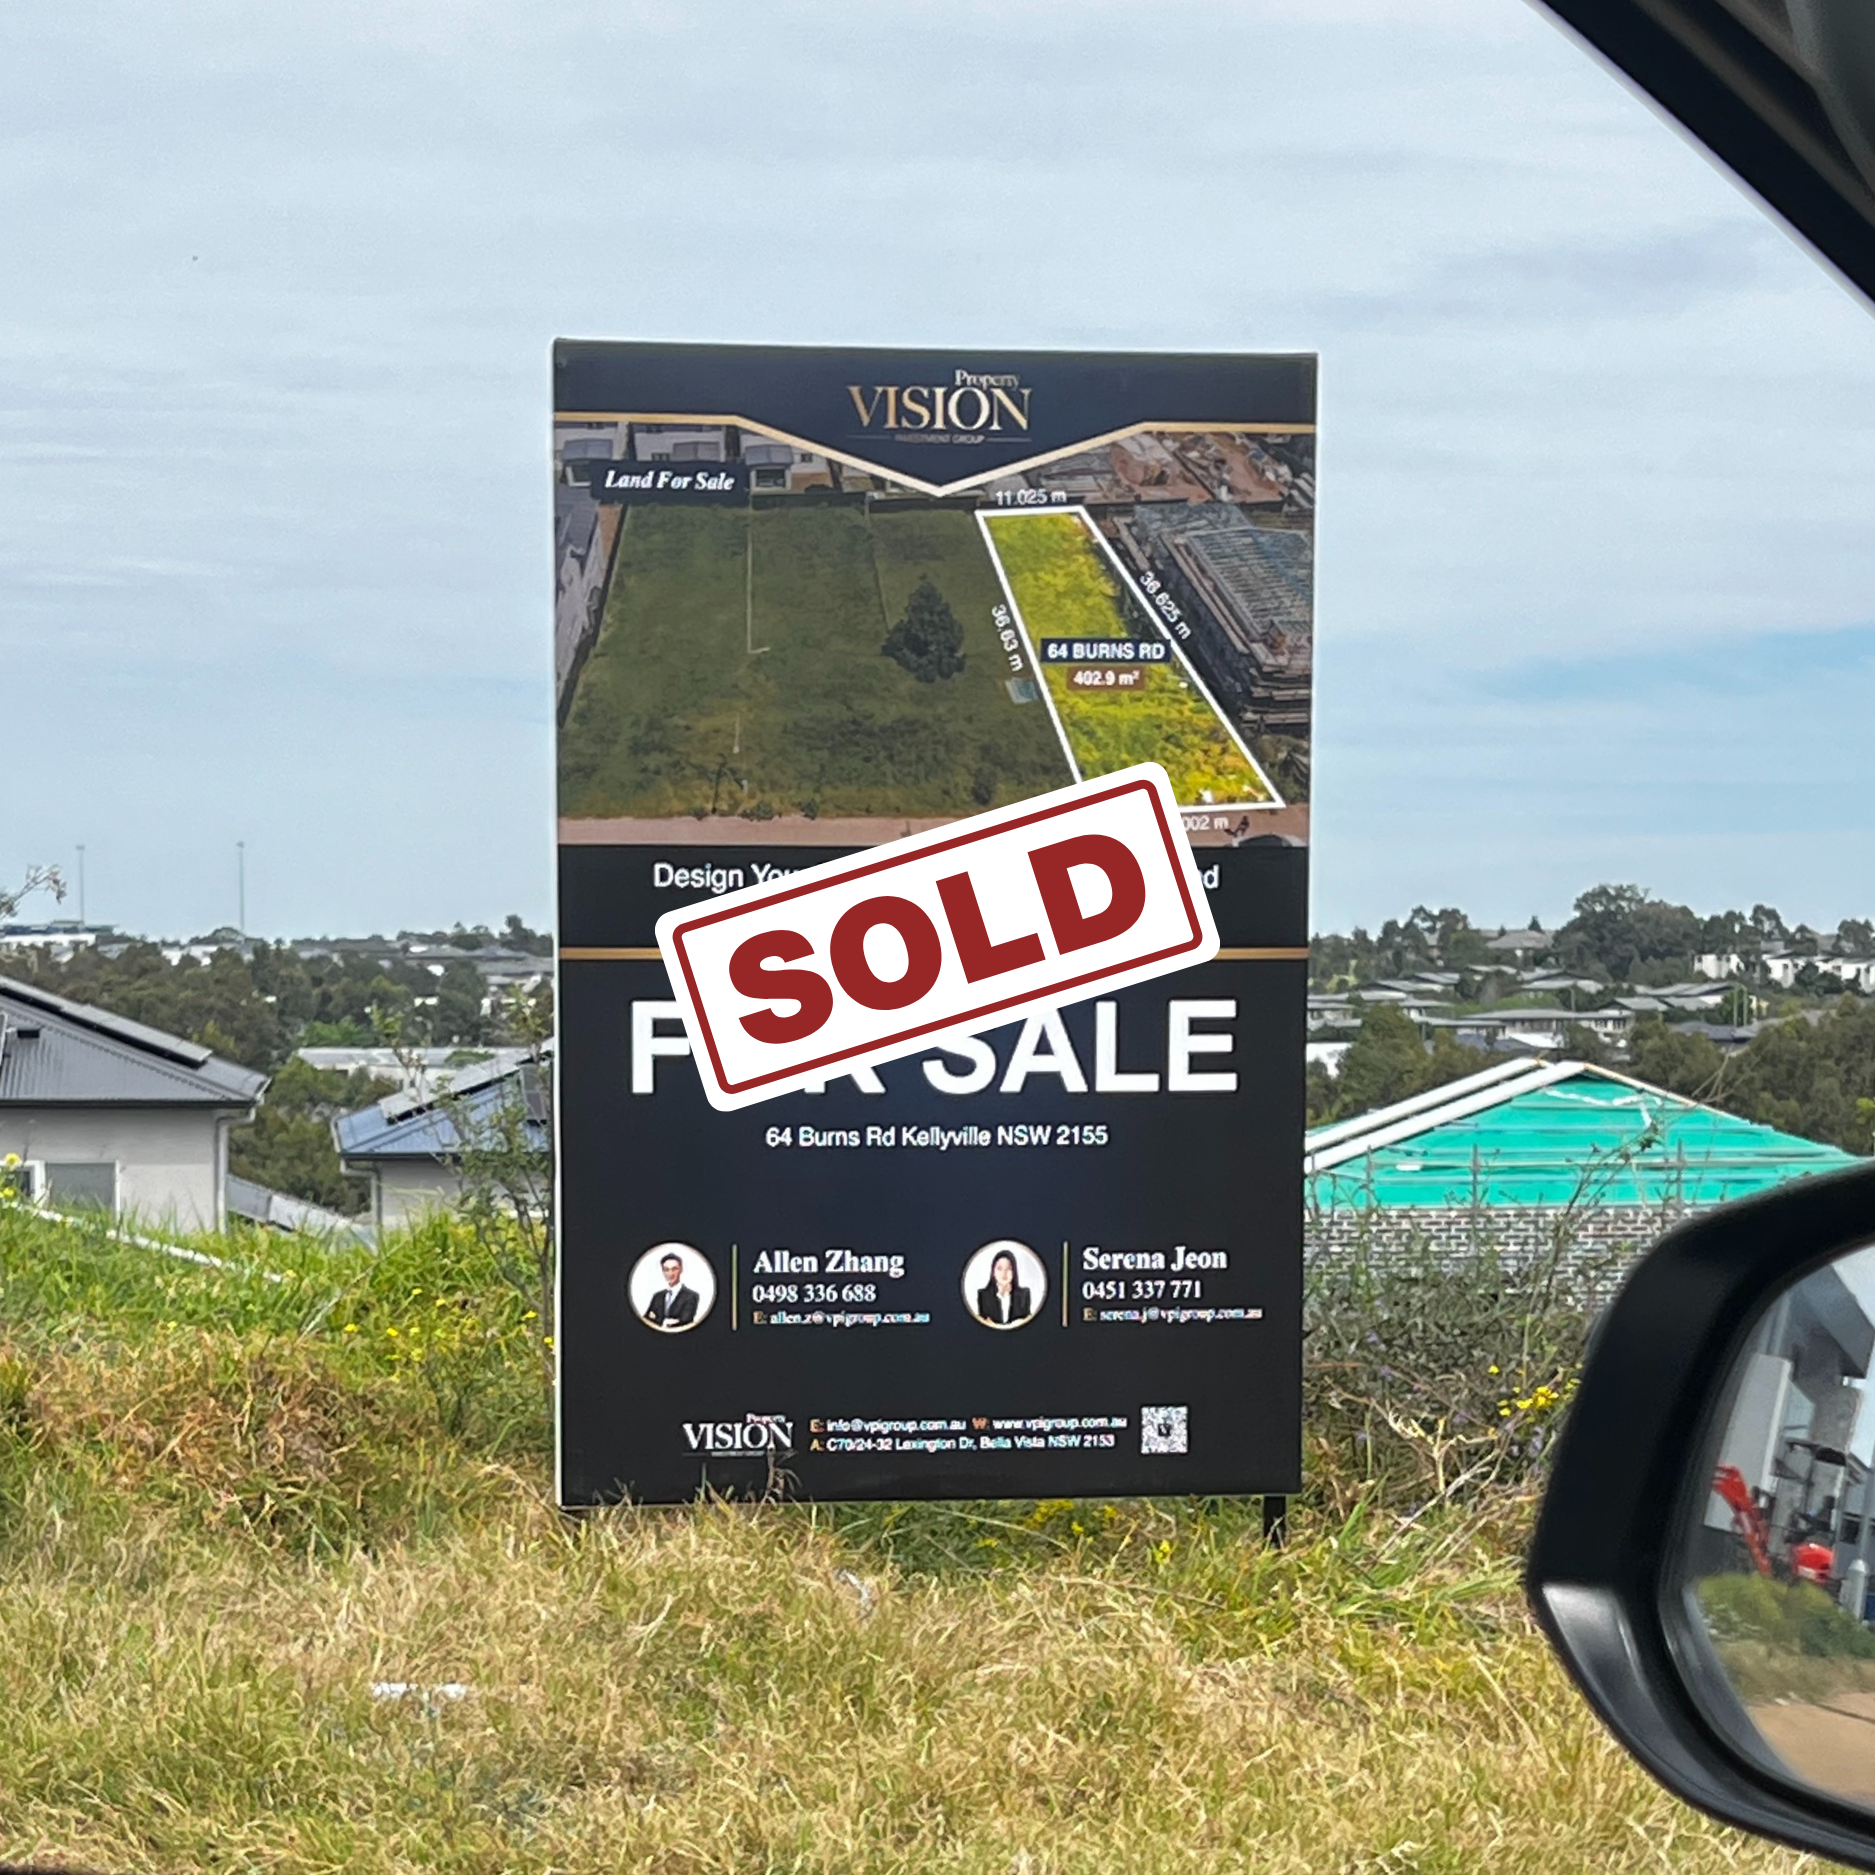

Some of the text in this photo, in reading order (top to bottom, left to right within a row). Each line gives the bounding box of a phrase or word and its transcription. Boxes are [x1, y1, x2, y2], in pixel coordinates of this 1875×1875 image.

[846, 385, 1032, 431] VISION
[604, 469, 735, 491] Land For Sale
[995, 488, 1068, 506] 11.025 m
[1174, 619, 1192, 640] m
[1047, 641, 1166, 660] 64 BURNS RD
[1008, 653, 1024, 672] m
[1073, 669, 1116, 686] 402.9
[1213, 816, 1229, 830] m
[653, 862, 744, 894] Design
[765, 1125, 1109, 1150] 64 Burns Rd Kellyville NSW 2155
[753, 1250, 905, 1278] Allen Zhang
[1082, 1246, 1228, 1271] Serena Jeon
[752, 1284, 876, 1302] 0498 336 688
[1082, 1280, 1202, 1300] 0451 337 771
[682, 1422, 794, 1450] VISION
[895, 1438, 956, 1453] Lexington
[979, 1436, 1012, 1449] Bella
[1014, 1436, 1045, 1448] Vista
[1048, 1435, 1081, 1447] NSW
